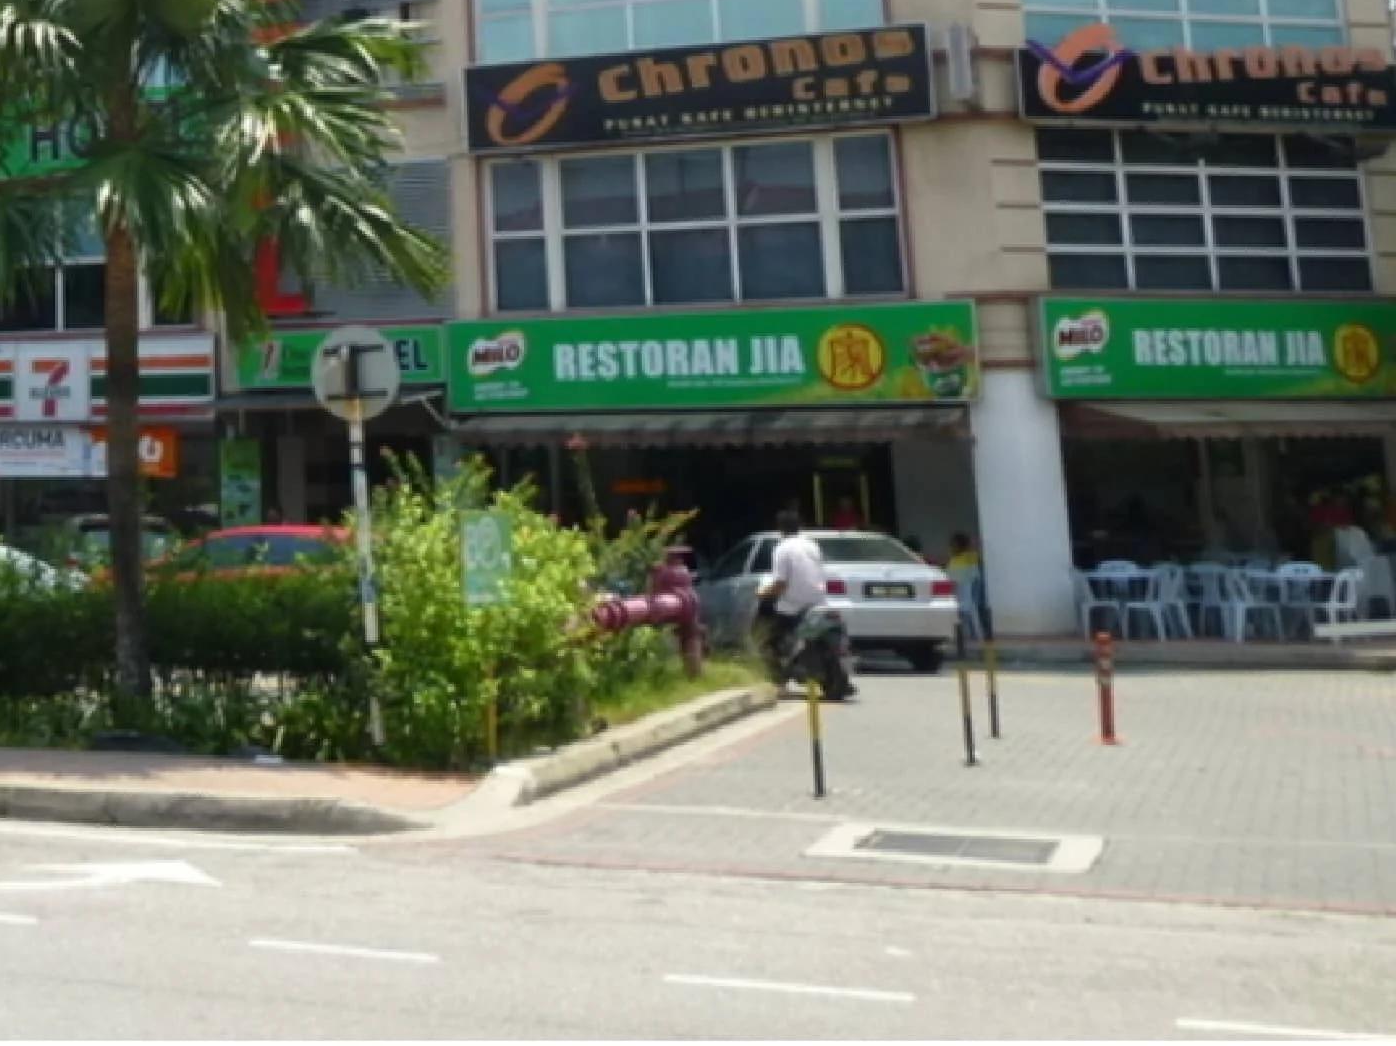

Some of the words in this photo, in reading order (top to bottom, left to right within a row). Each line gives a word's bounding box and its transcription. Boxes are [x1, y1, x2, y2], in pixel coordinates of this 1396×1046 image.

[552, 335, 738, 382] RESTORAN
[748, 334, 806, 376] JIA
[1132, 329, 1278, 366] RESTORAN
[1285, 329, 1326, 366] JIA
[32, 359, 70, 418] 7
